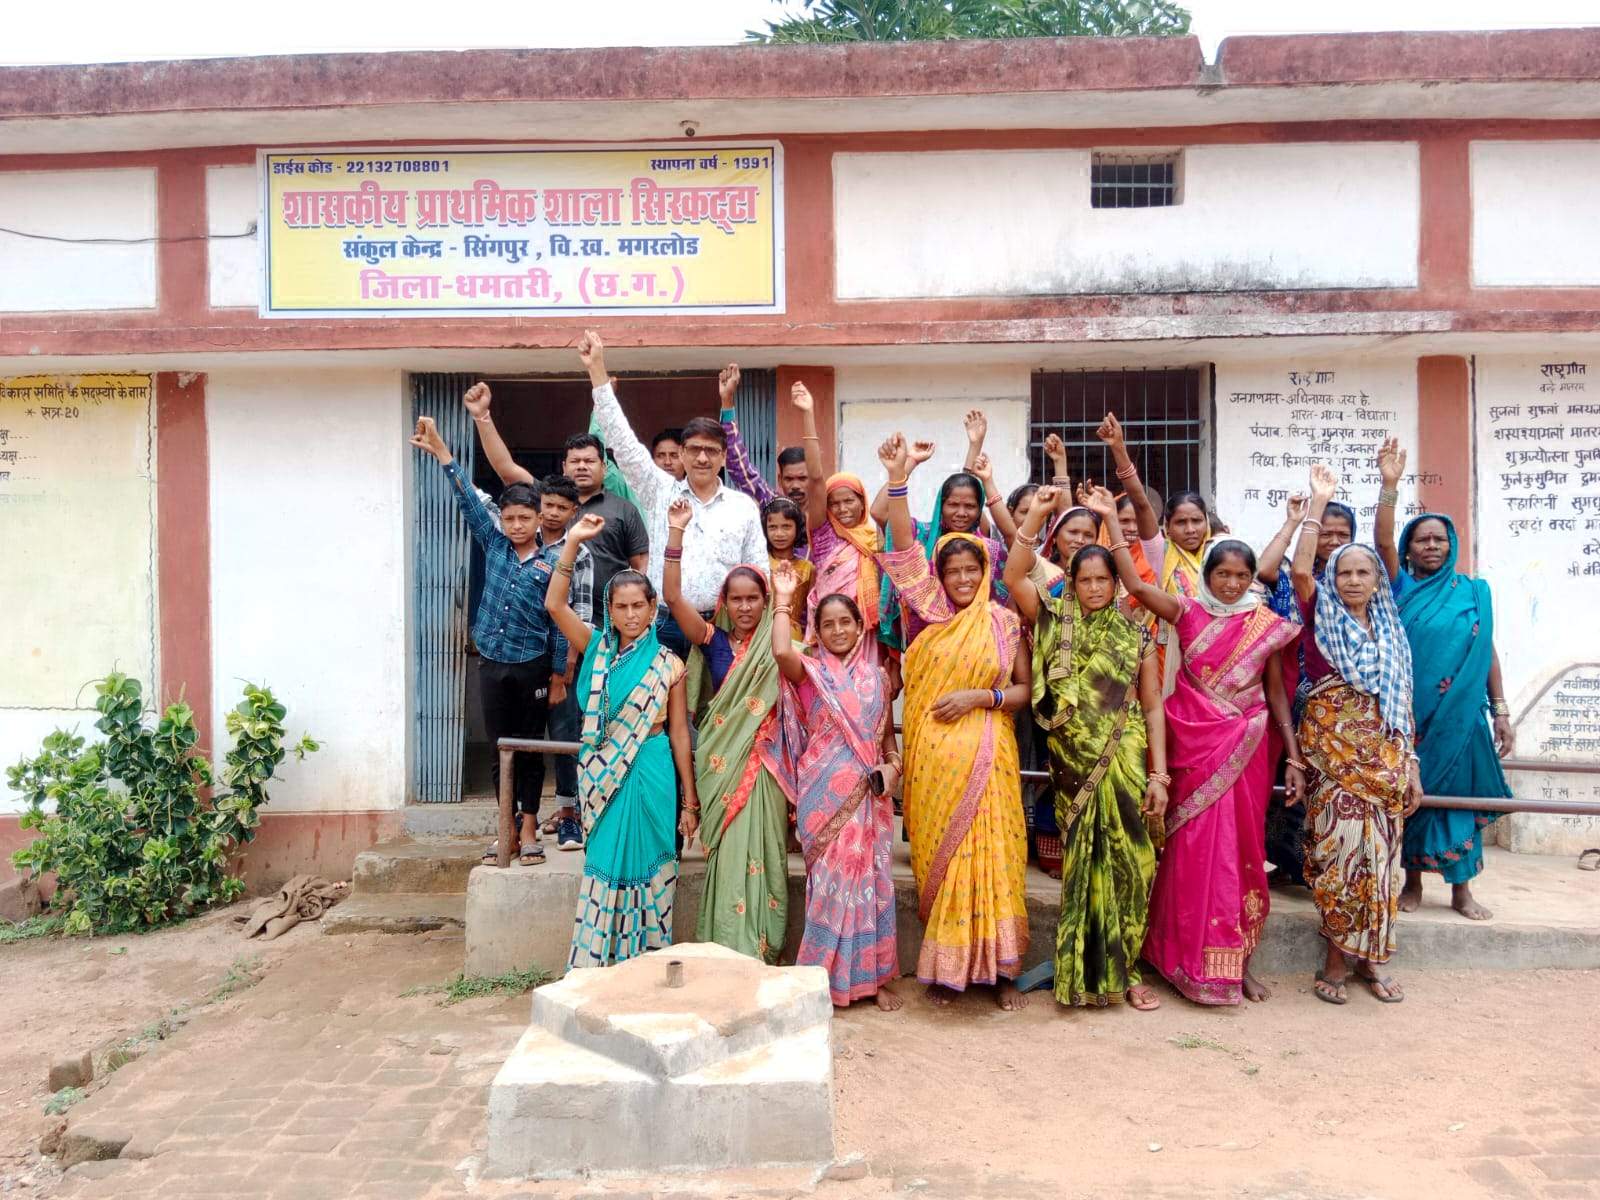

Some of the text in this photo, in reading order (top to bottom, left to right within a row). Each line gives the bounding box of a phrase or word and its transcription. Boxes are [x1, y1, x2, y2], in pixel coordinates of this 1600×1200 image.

[273, 159, 305, 175] डाईस
[307, 158, 333, 174] कोड
[346, 160, 449, 173] 22132708801
[650, 157, 696, 171] स्थापना
[699, 154, 719, 170] वर्ष
[733, 157, 769, 169] 1991
[283, 177, 760, 234] शासकीय प्राथमिक शाला सिरकट्टा
[343, 235, 398, 265] संकुल
[402, 235, 443, 258] केन्द्र
[463, 234, 529, 263] सिंगपुर
[617, 232, 700, 256] मगरलोड
[578, 266, 685, 305] (छ.ग.)
